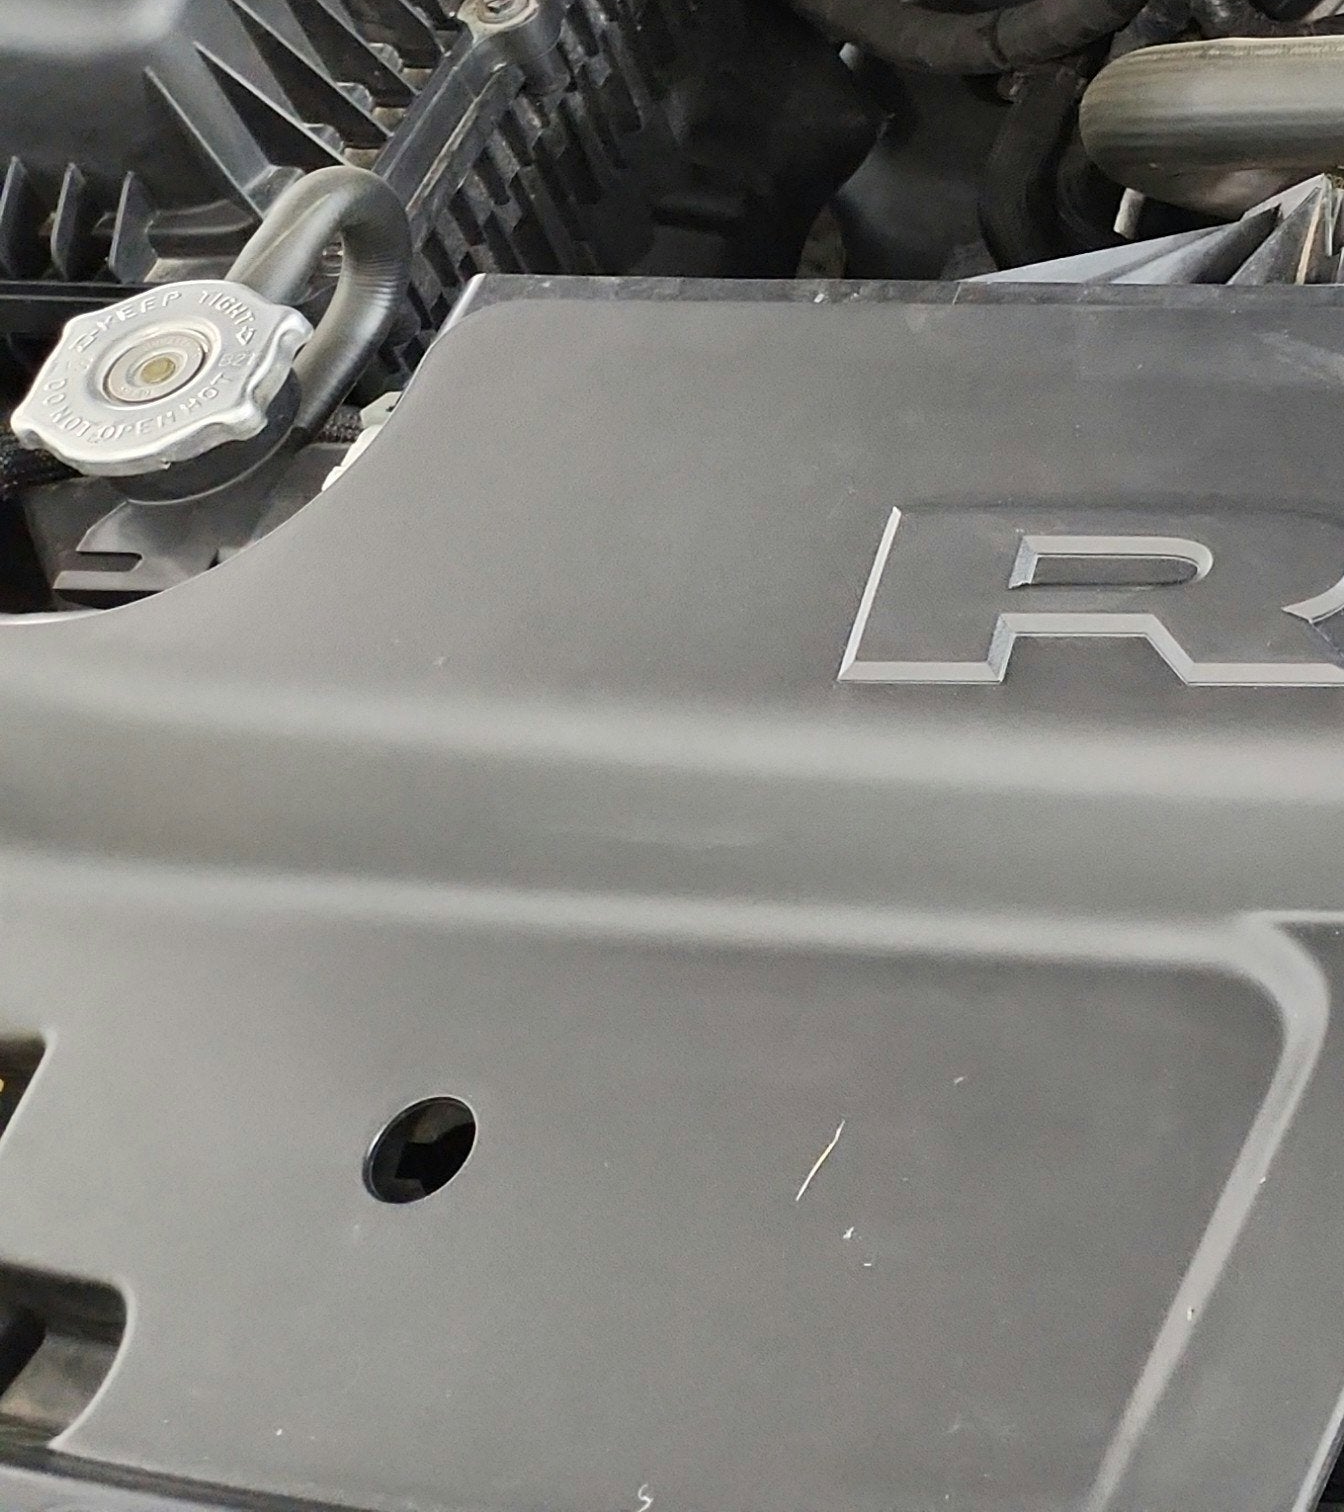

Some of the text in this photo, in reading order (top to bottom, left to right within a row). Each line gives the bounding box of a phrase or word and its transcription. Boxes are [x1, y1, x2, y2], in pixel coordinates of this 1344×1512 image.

[96, 291, 256, 331] KEEP TIGHT
[50, 407, 92, 438] NOT
[98, 410, 177, 442] OPEN
[180, 371, 233, 414] HOT
